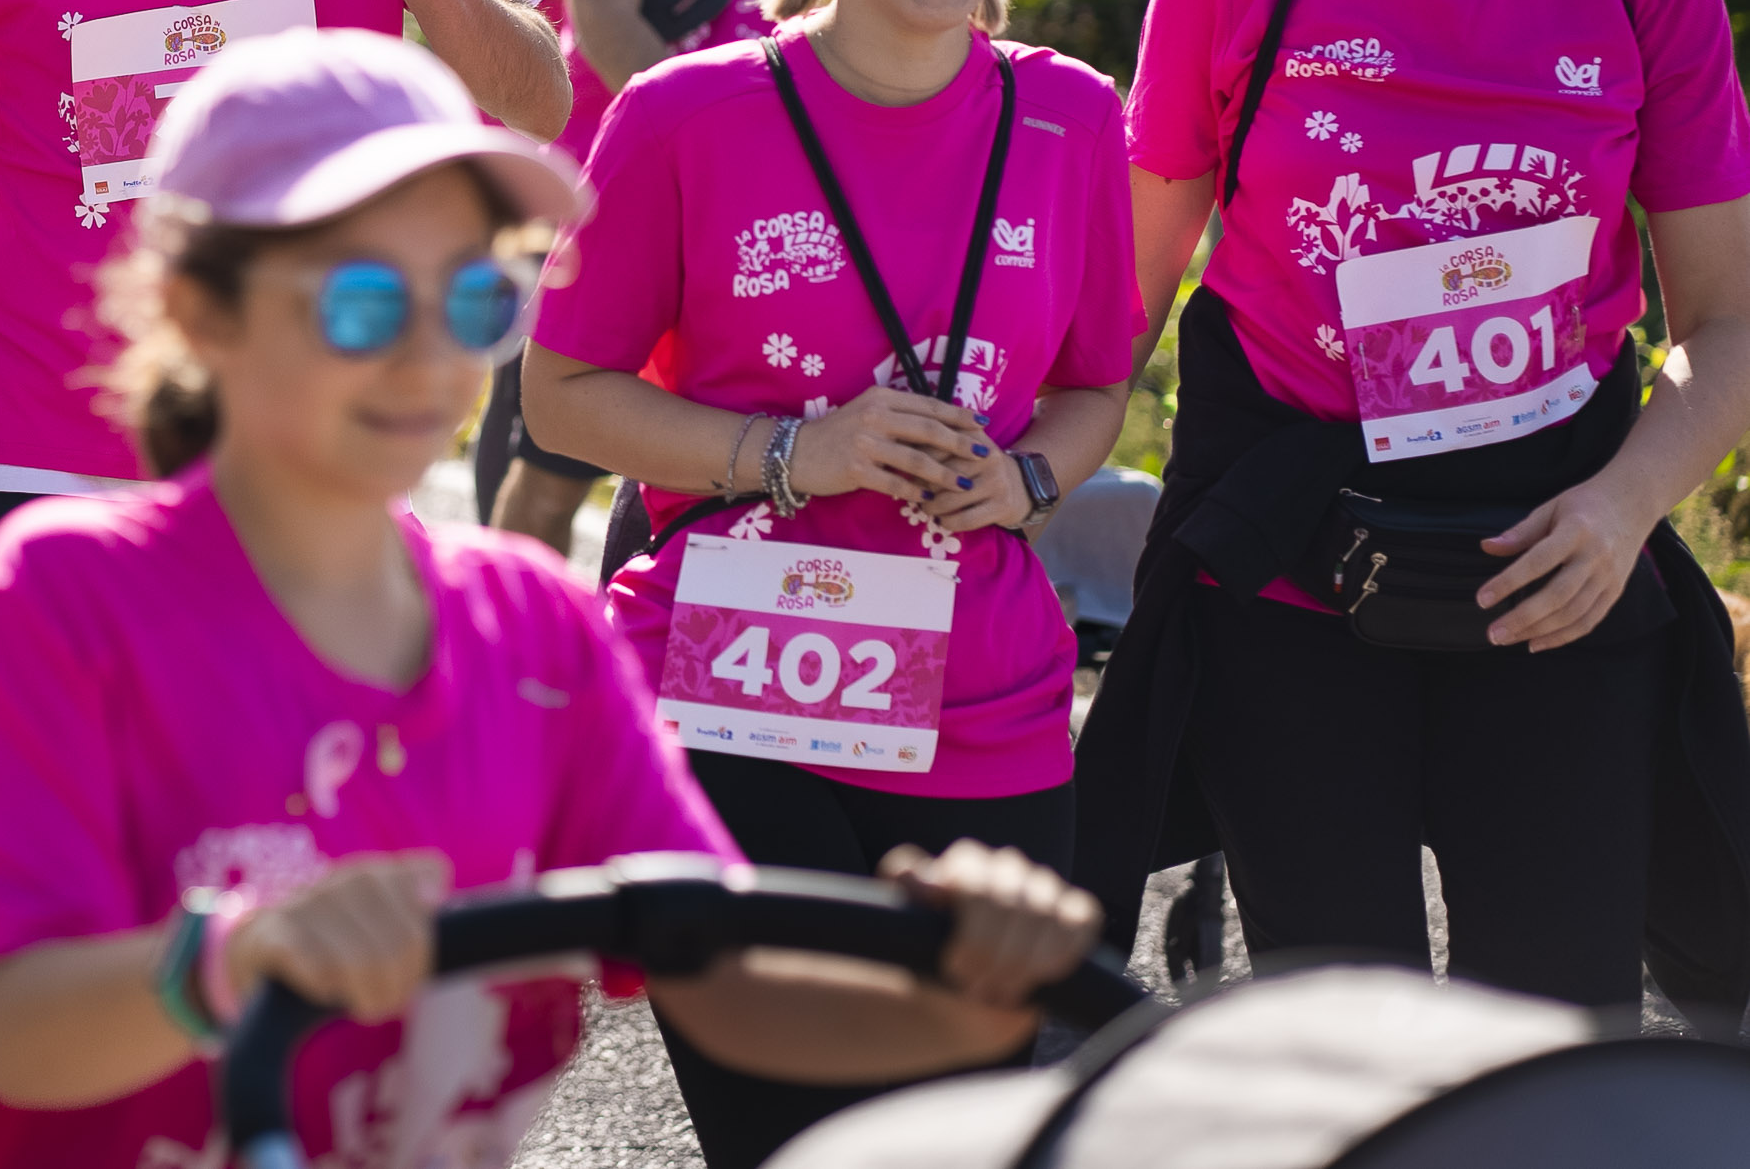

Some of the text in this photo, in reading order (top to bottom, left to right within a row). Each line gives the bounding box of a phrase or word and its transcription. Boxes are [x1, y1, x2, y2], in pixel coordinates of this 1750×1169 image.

[173, 14, 212, 32] CORSA
[164, 48, 196, 66] ROSA
[1285, 58, 1339, 78] ROSA
[1555, 55, 1602, 88] Sei
[734, 229, 752, 246] LA
[753, 210, 825, 240] CORSA
[992, 217, 1036, 252] Sei
[1450, 245, 1494, 268] CORSA
[732, 268, 790, 298] ROSA
[1442, 285, 1480, 306] ROSA
[1408, 303, 1556, 393] 401
[796, 558, 844, 573] CORSA
[776, 593, 815, 611] ROSA
[711, 625, 898, 712] 402
